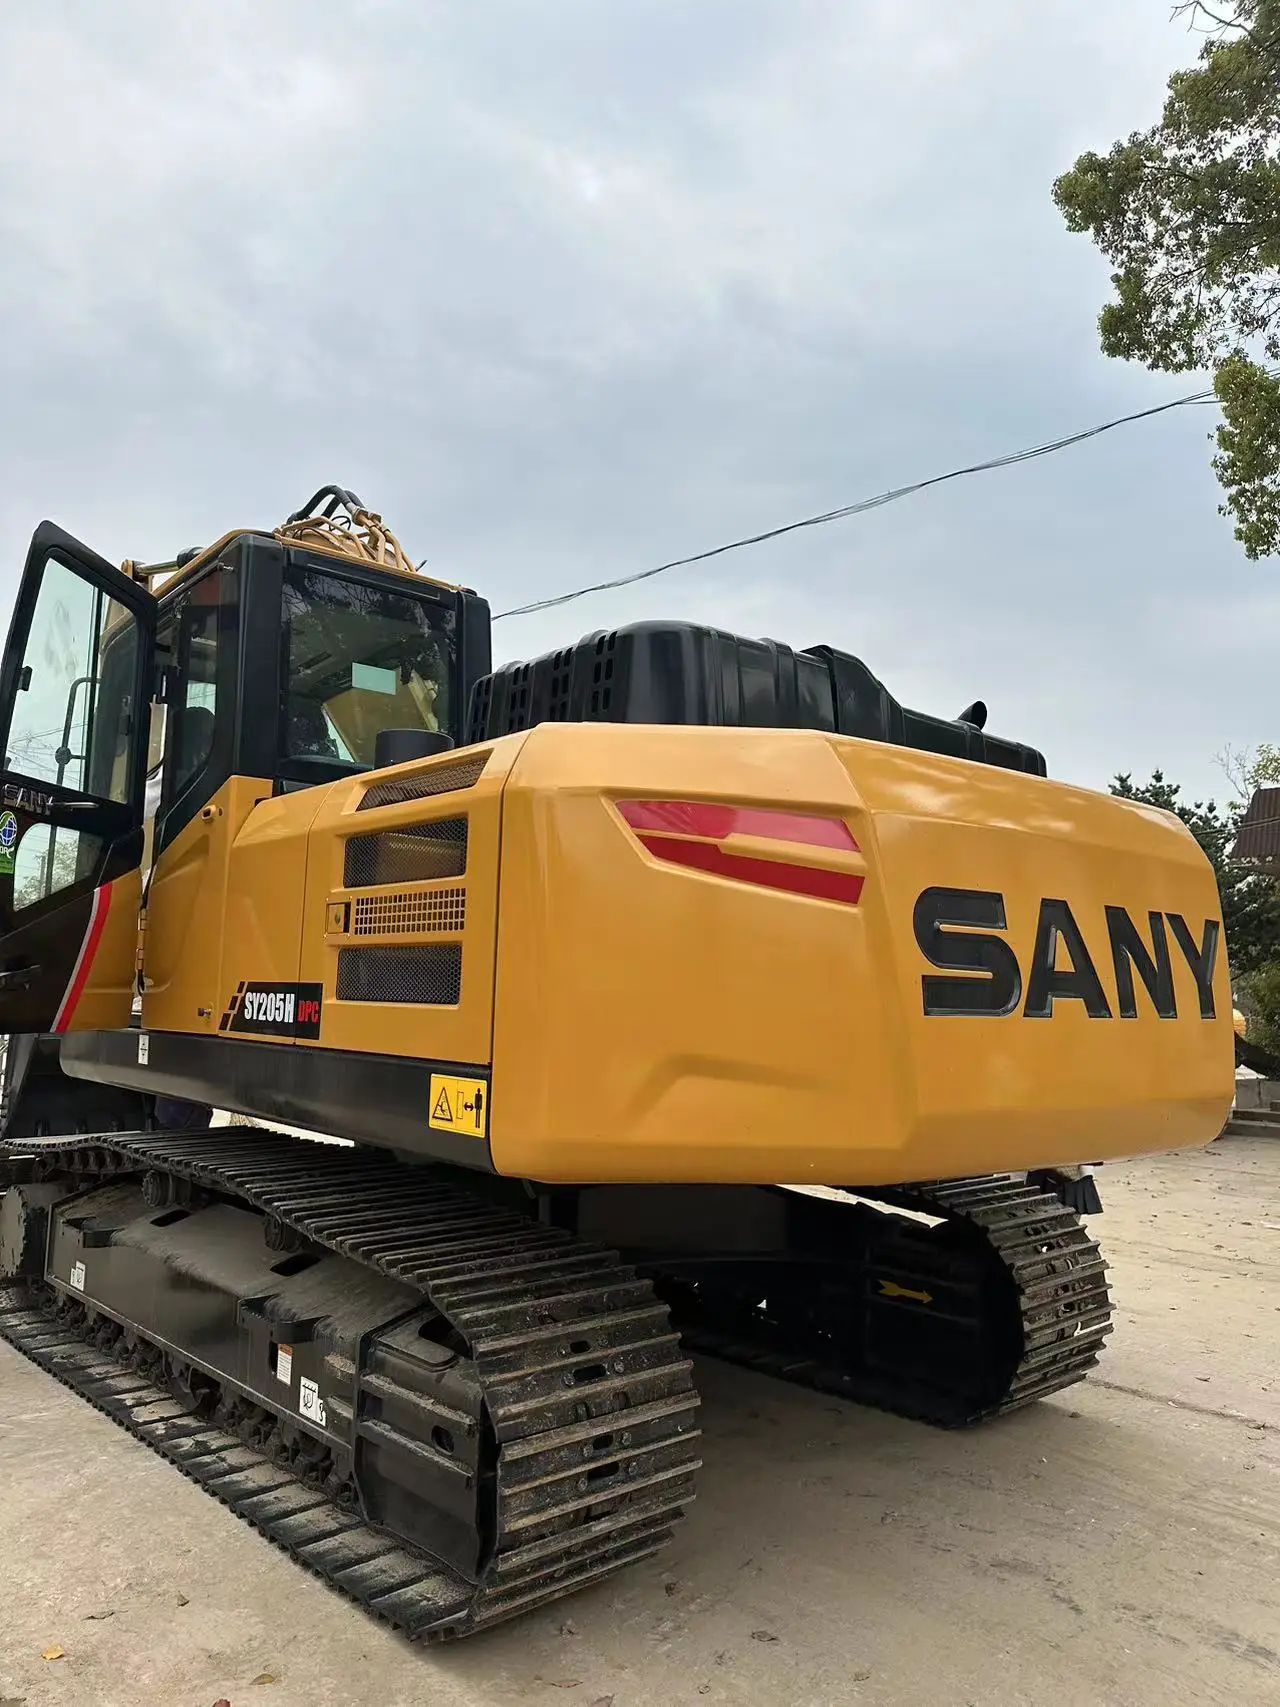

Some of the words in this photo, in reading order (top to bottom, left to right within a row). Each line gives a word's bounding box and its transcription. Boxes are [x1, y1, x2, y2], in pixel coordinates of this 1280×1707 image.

[913, 886, 1220, 1019] SANY
[244, 991, 295, 1023] SY205H
[297, 1000, 320, 1023] DPC
